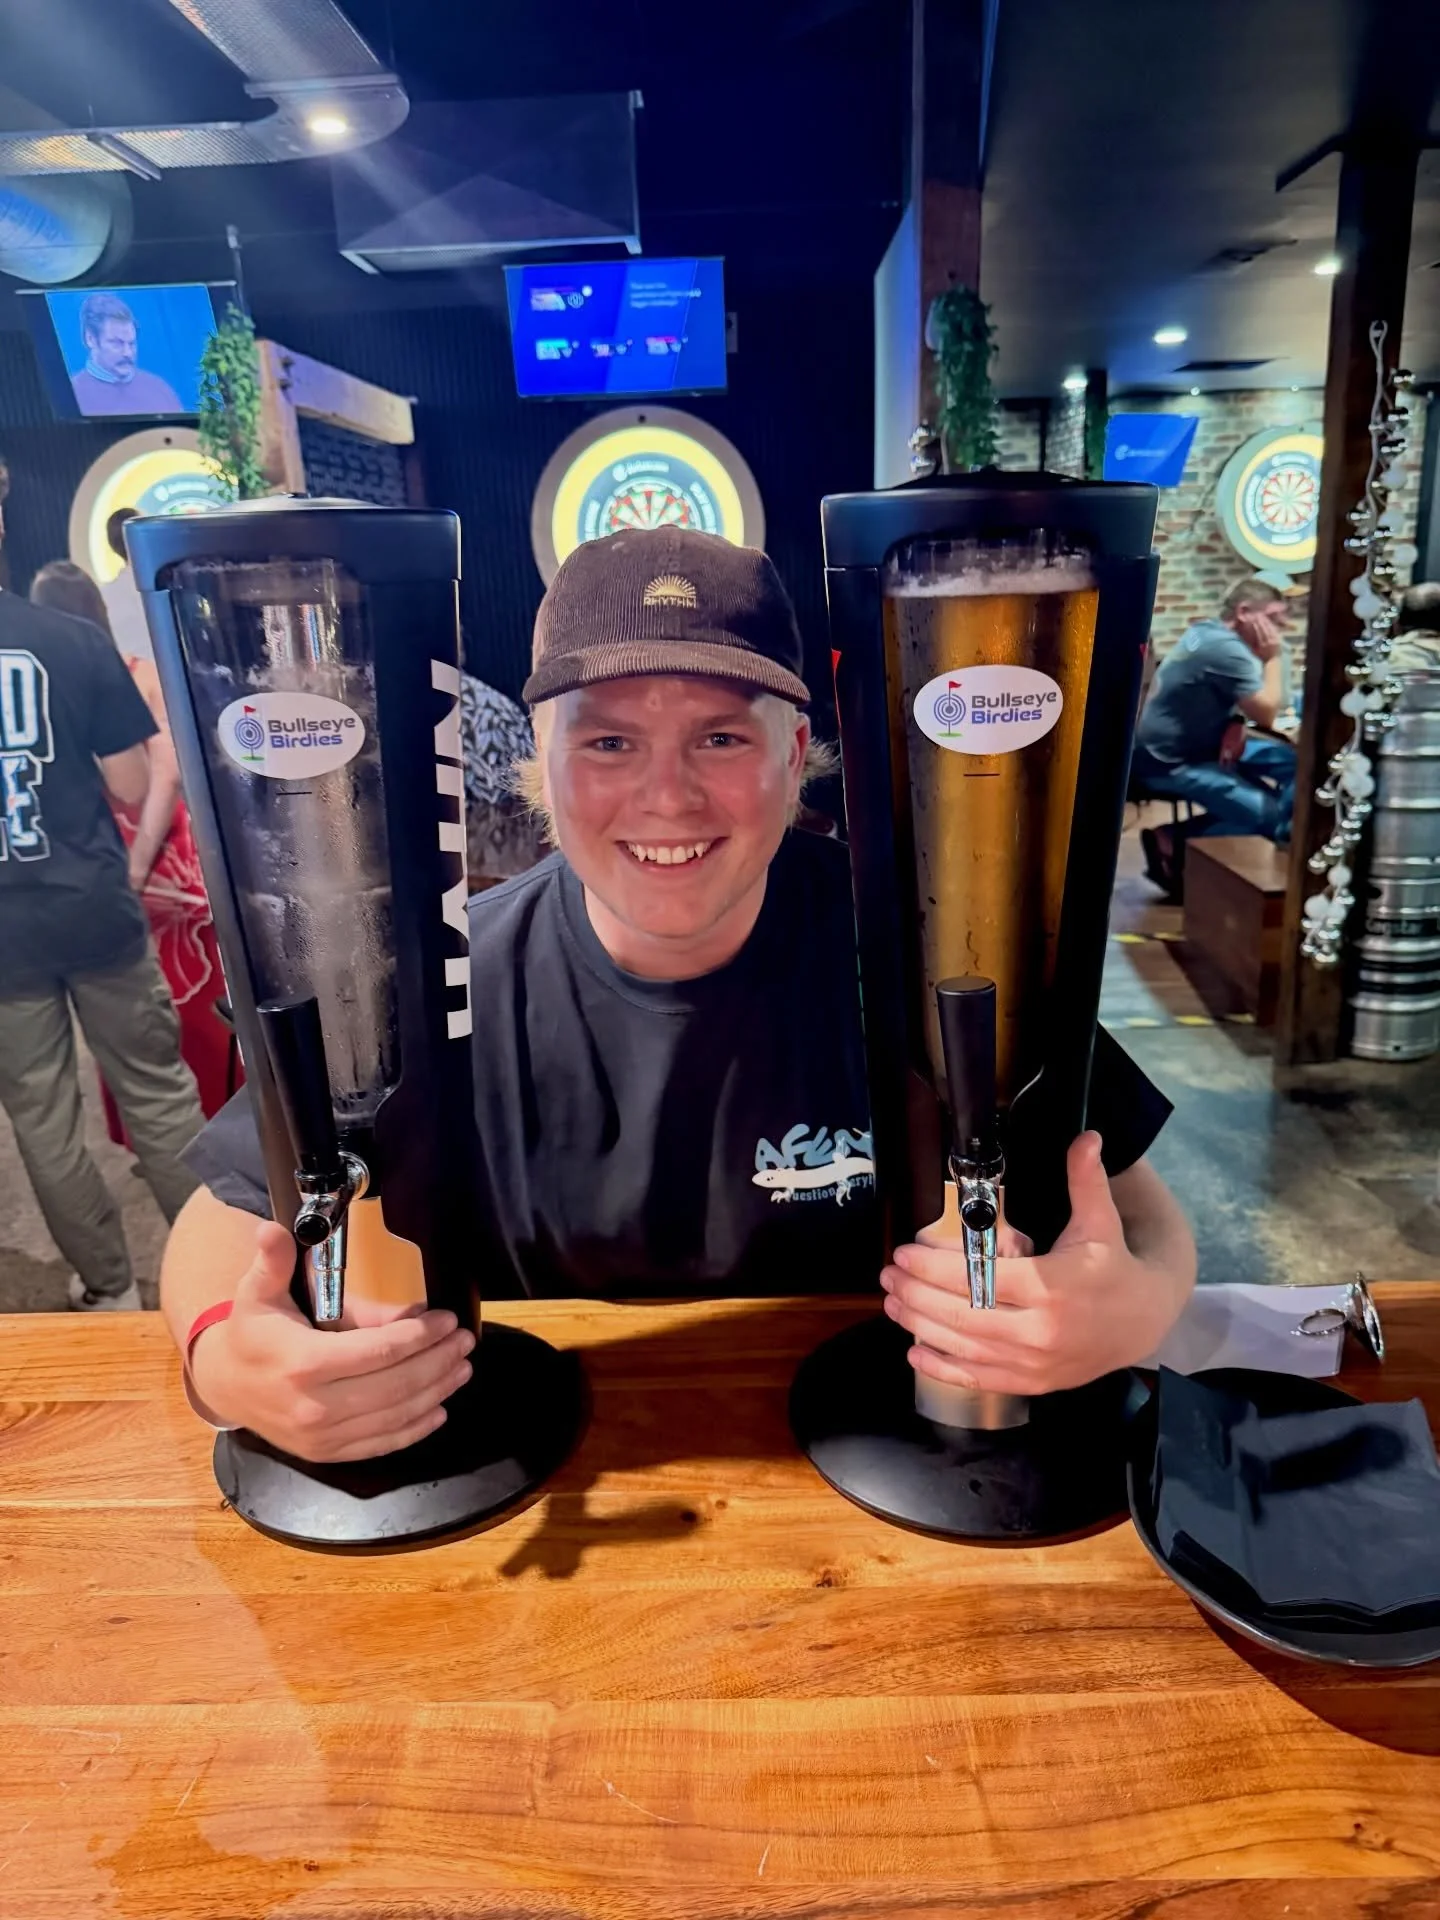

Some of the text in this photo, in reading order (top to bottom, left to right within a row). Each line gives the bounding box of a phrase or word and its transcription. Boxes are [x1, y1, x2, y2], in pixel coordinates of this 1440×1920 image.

[643, 596, 696, 608] RHYTHM
[972, 691, 1057, 709] Bullseye
[971, 708, 1043, 724] Birdies
[268, 717, 355, 733] Bullseye
[270, 733, 343, 748] Birdies
[791, 1187, 837, 1201] uestion
